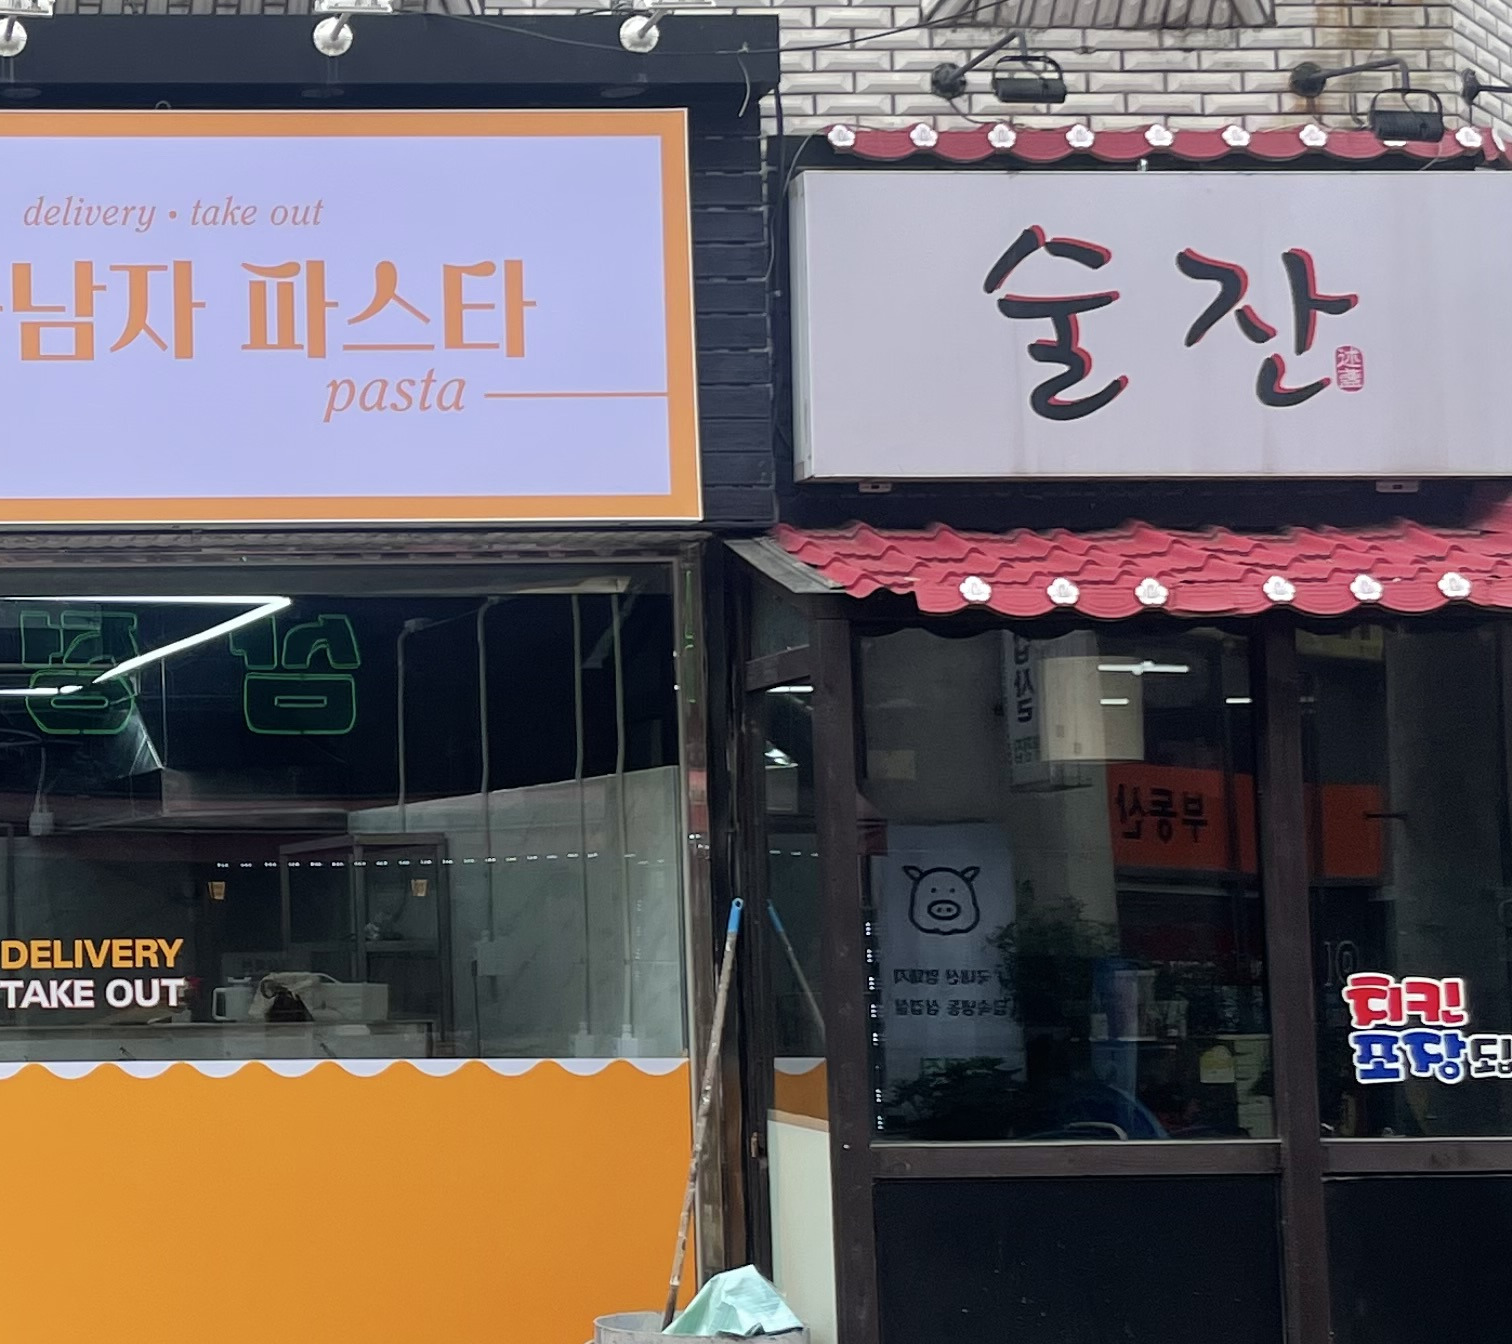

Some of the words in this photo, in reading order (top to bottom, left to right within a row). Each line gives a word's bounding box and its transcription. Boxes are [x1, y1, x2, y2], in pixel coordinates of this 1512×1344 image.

[24, 197, 157, 234] delivery
[191, 197, 259, 227] take
[270, 200, 325, 227] out
[241, 260, 538, 360] 파스타
[323, 368, 468, 424] pasta
[0, 938, 184, 970] DELIVERY
[0, 978, 96, 1009] TAKE
[105, 977, 186, 1008] OUT
[1341, 972, 1469, 1030] 치킨
